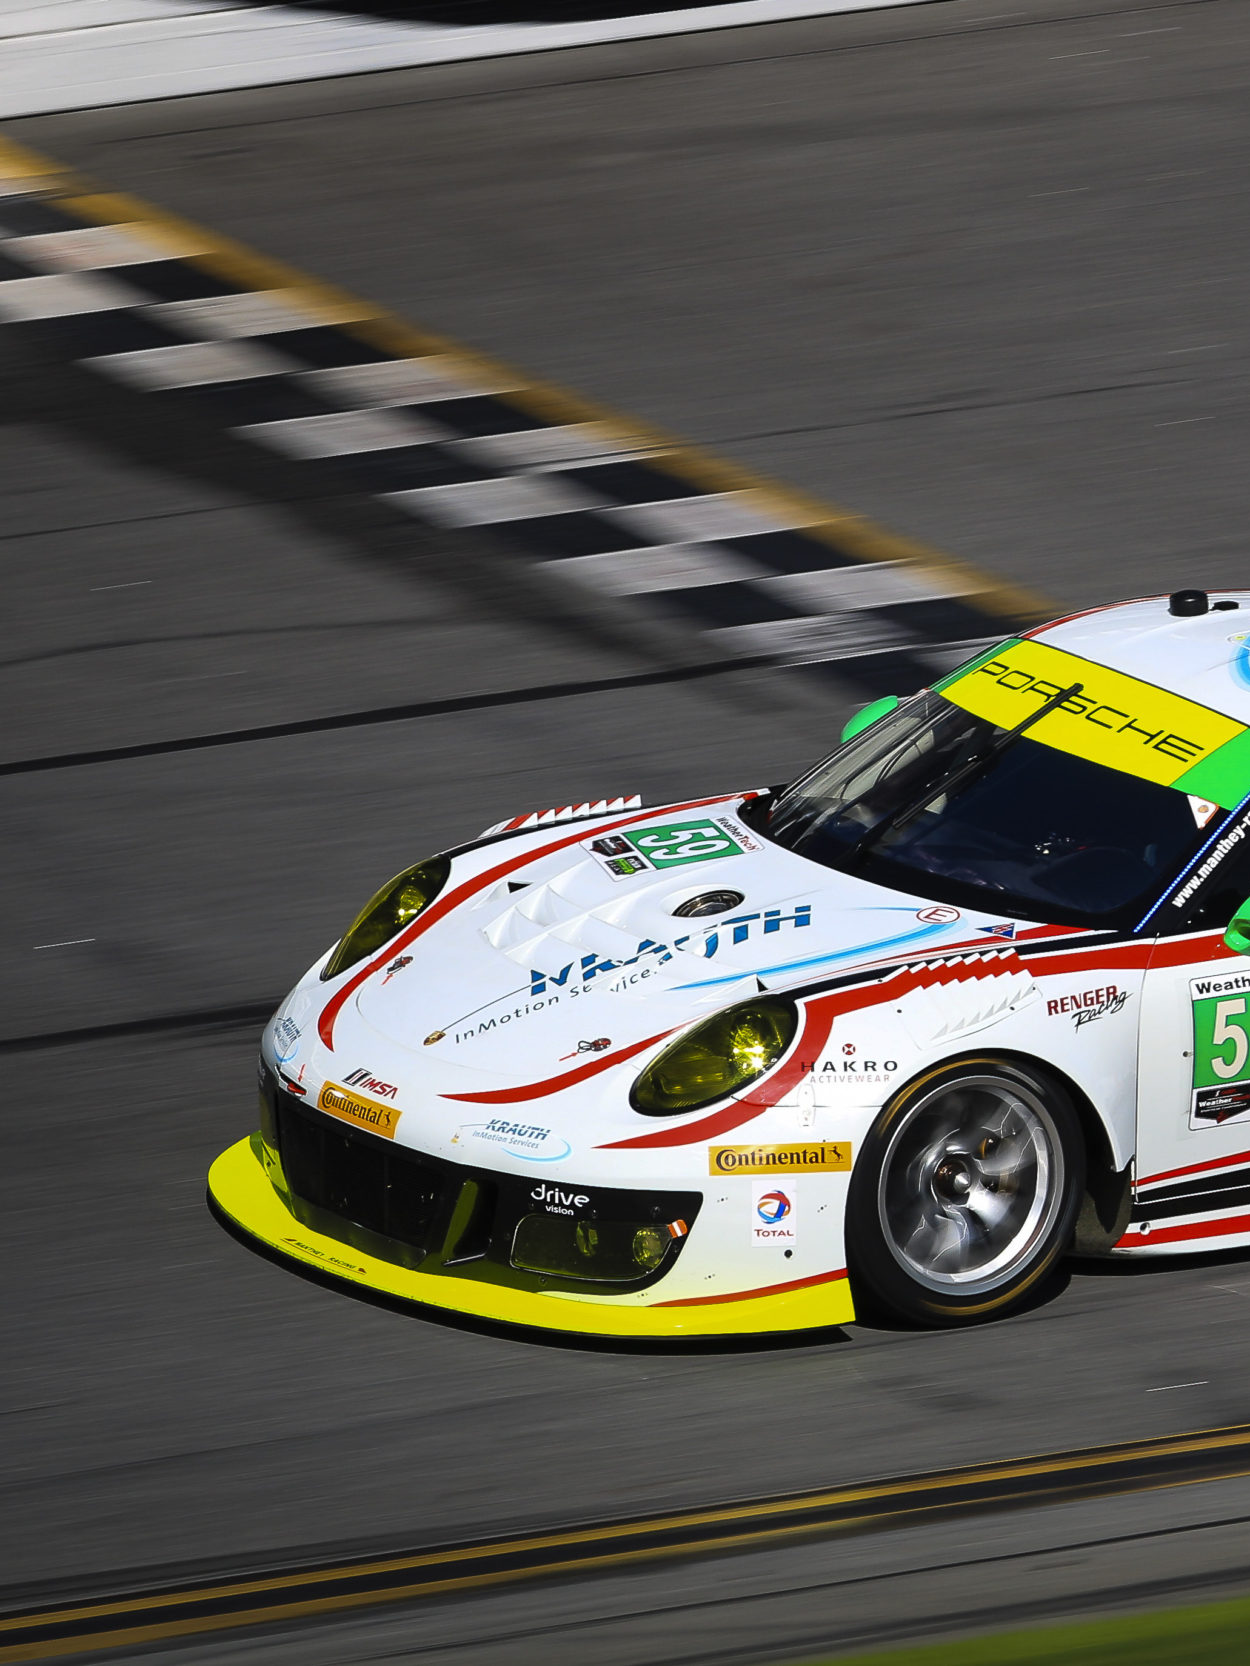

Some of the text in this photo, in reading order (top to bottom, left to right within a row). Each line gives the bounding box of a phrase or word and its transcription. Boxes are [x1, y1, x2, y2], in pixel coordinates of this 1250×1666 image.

[637, 826, 731, 860] 59
[1046, 985, 1118, 1016] RENGER
[455, 996, 559, 1044] InMotion
[1070, 991, 1134, 1034] Racing
[801, 1060, 898, 1072] HAKRO
[810, 1074, 890, 1084] ACTIVEWEAR
[322, 1086, 384, 1125] Continental
[485, 1118, 551, 1141] KRAUTH
[508, 1137, 539, 1149] Services
[716, 1147, 826, 1171] Continental
[530, 1184, 590, 1207] drive
[545, 1204, 574, 1216] vision
[754, 1228, 794, 1238] TOTAL
